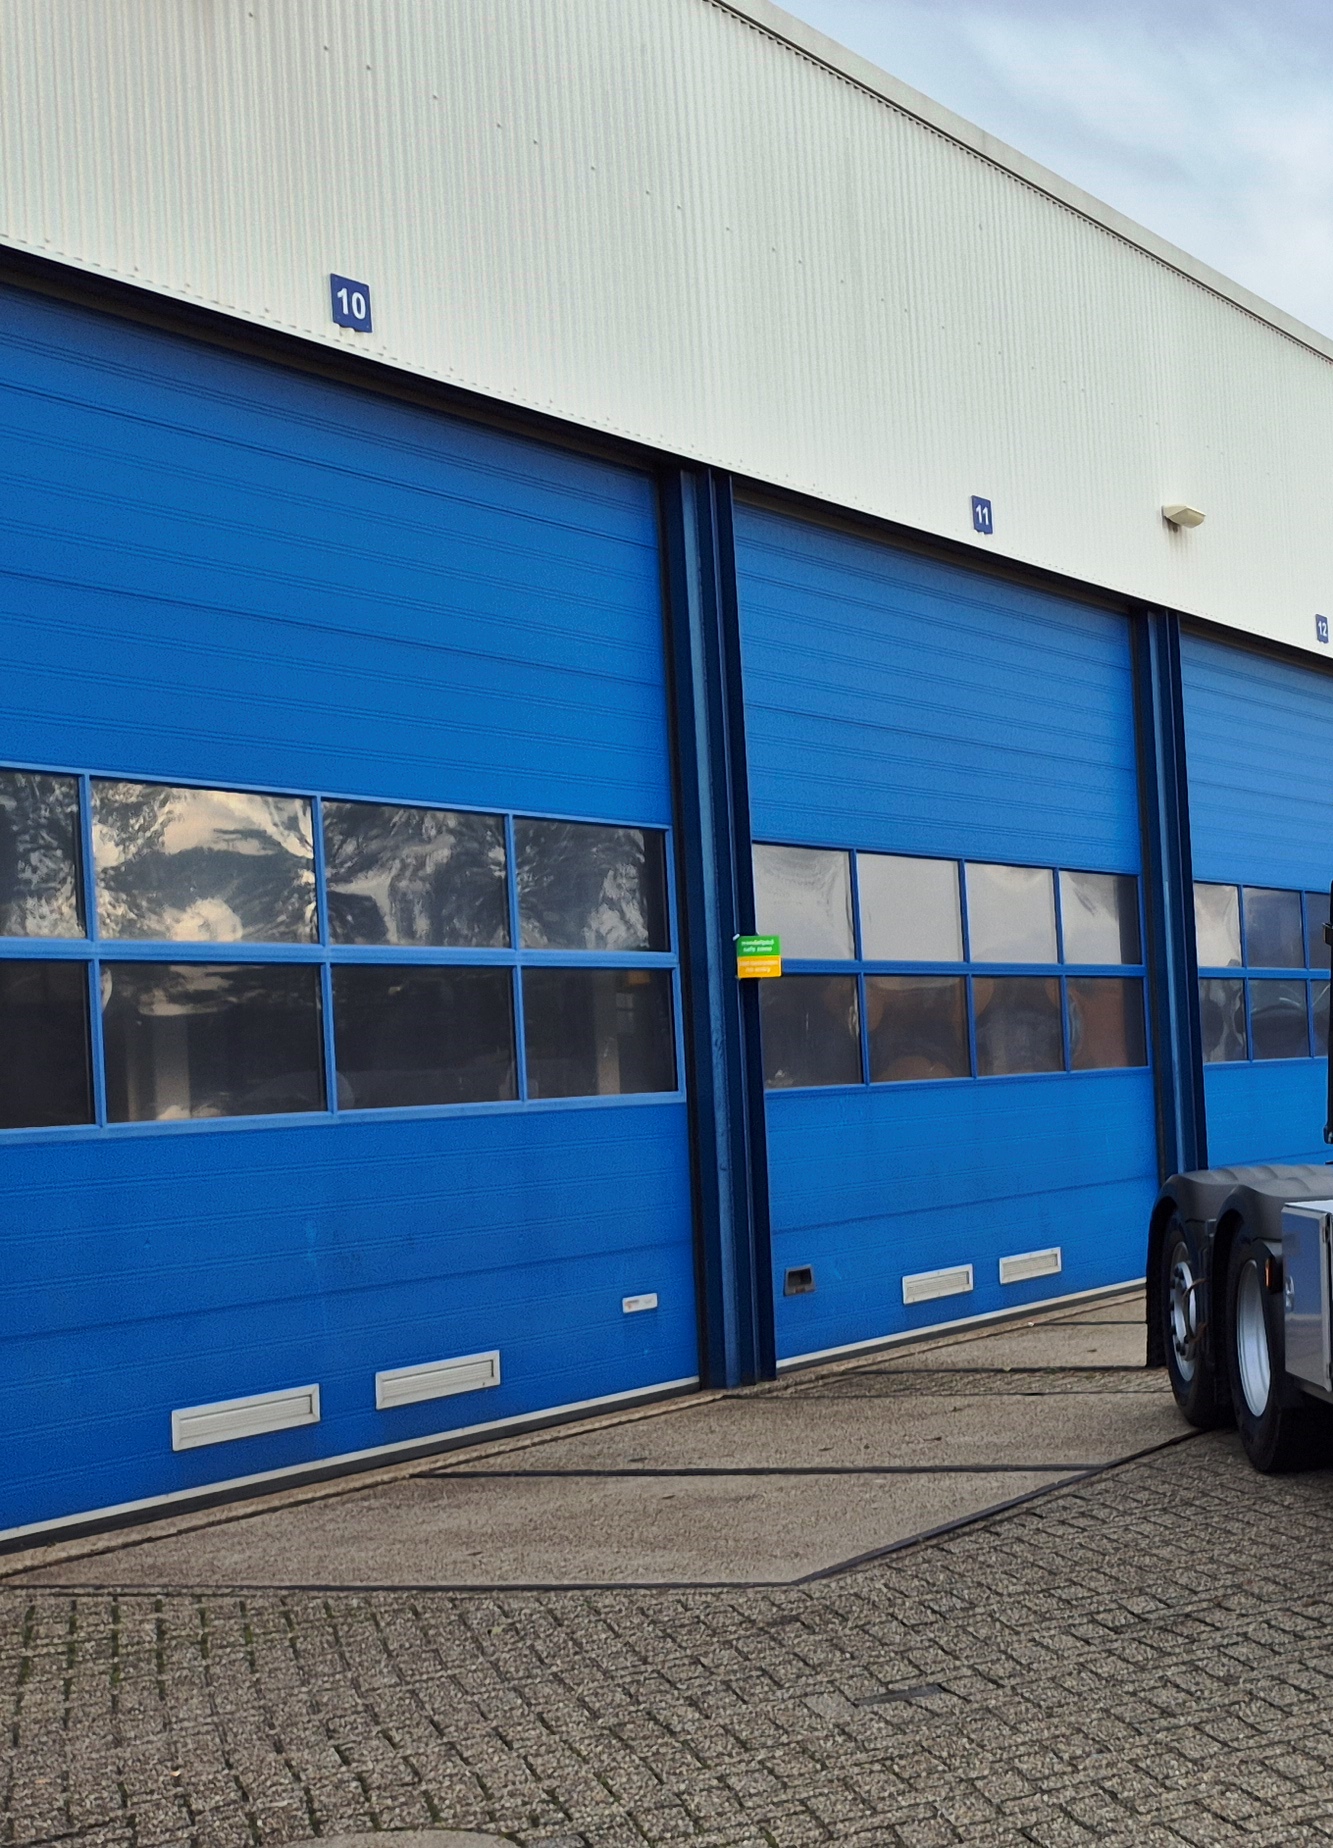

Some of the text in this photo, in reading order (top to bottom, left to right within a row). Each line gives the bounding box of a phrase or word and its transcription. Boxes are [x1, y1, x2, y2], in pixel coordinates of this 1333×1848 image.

[337, 287, 367, 320] 10
[975, 504, 990, 526] 11
[1317, 620, 1328, 637] 12
